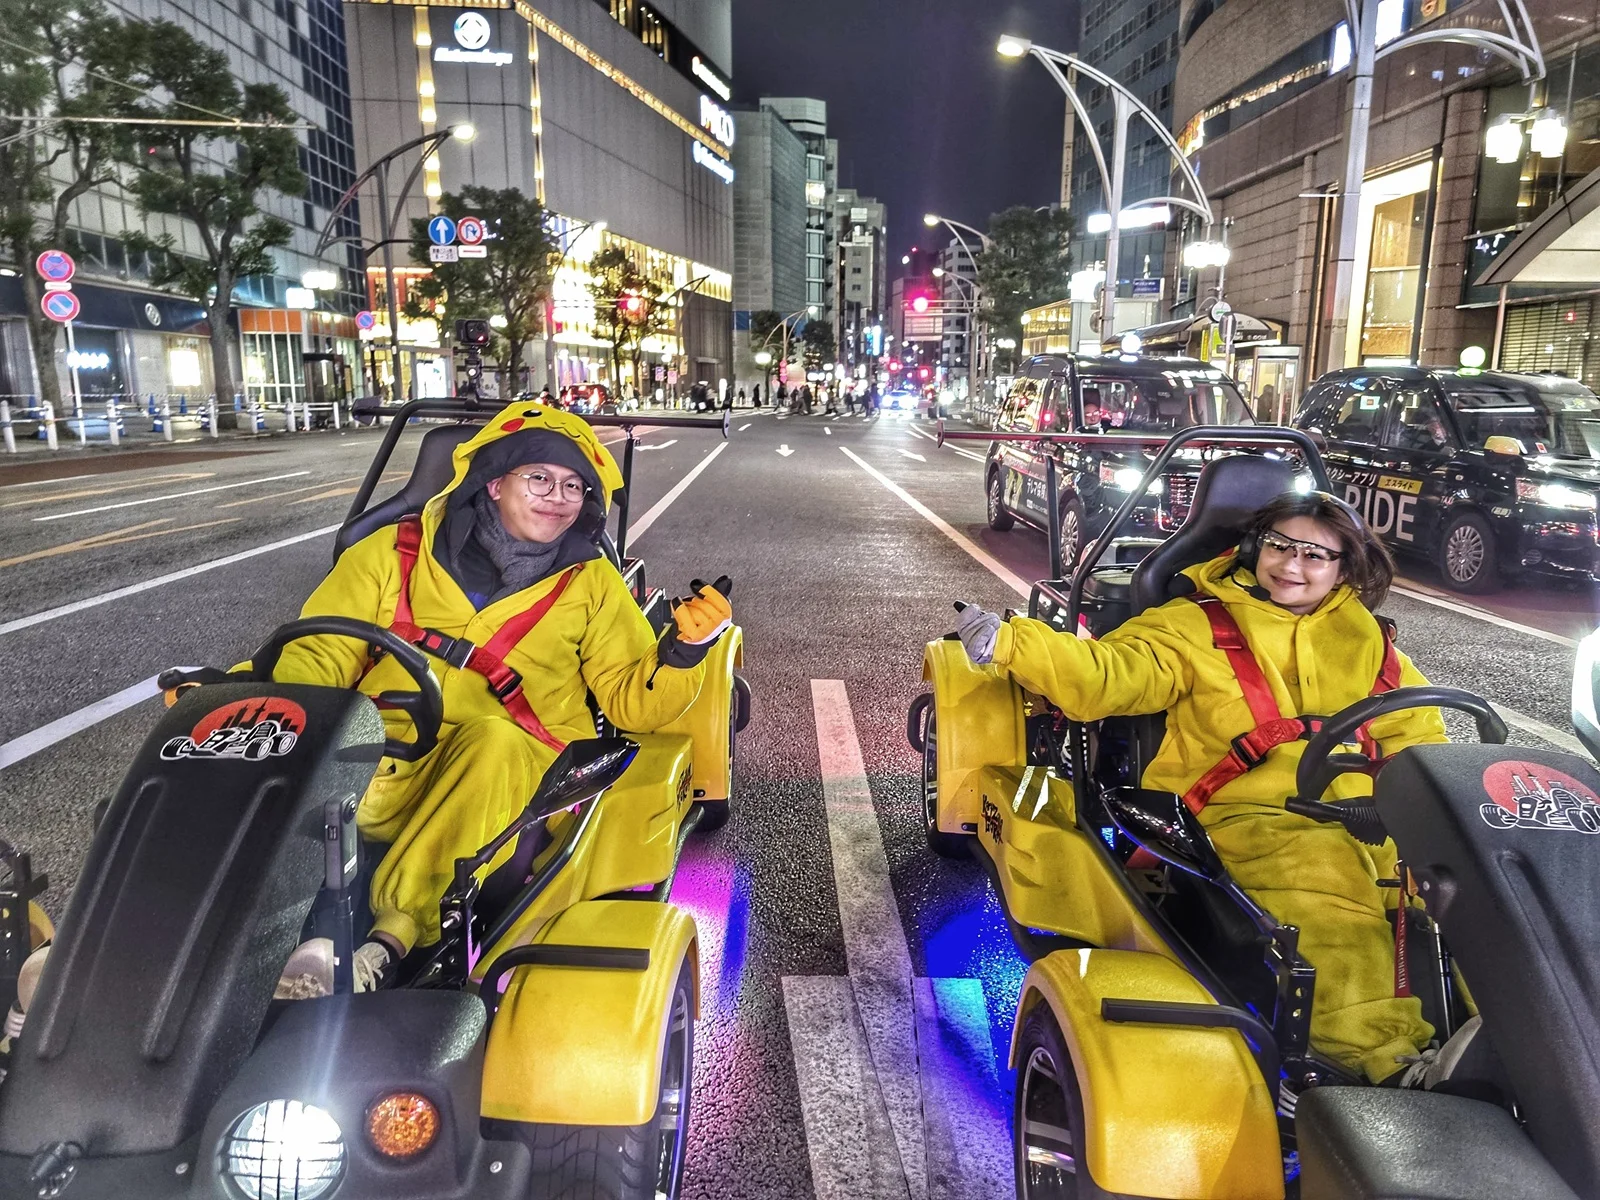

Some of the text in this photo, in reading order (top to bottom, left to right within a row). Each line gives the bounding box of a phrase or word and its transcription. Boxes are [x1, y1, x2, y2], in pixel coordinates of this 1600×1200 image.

[1384, 479, 1414, 491] エスライド
